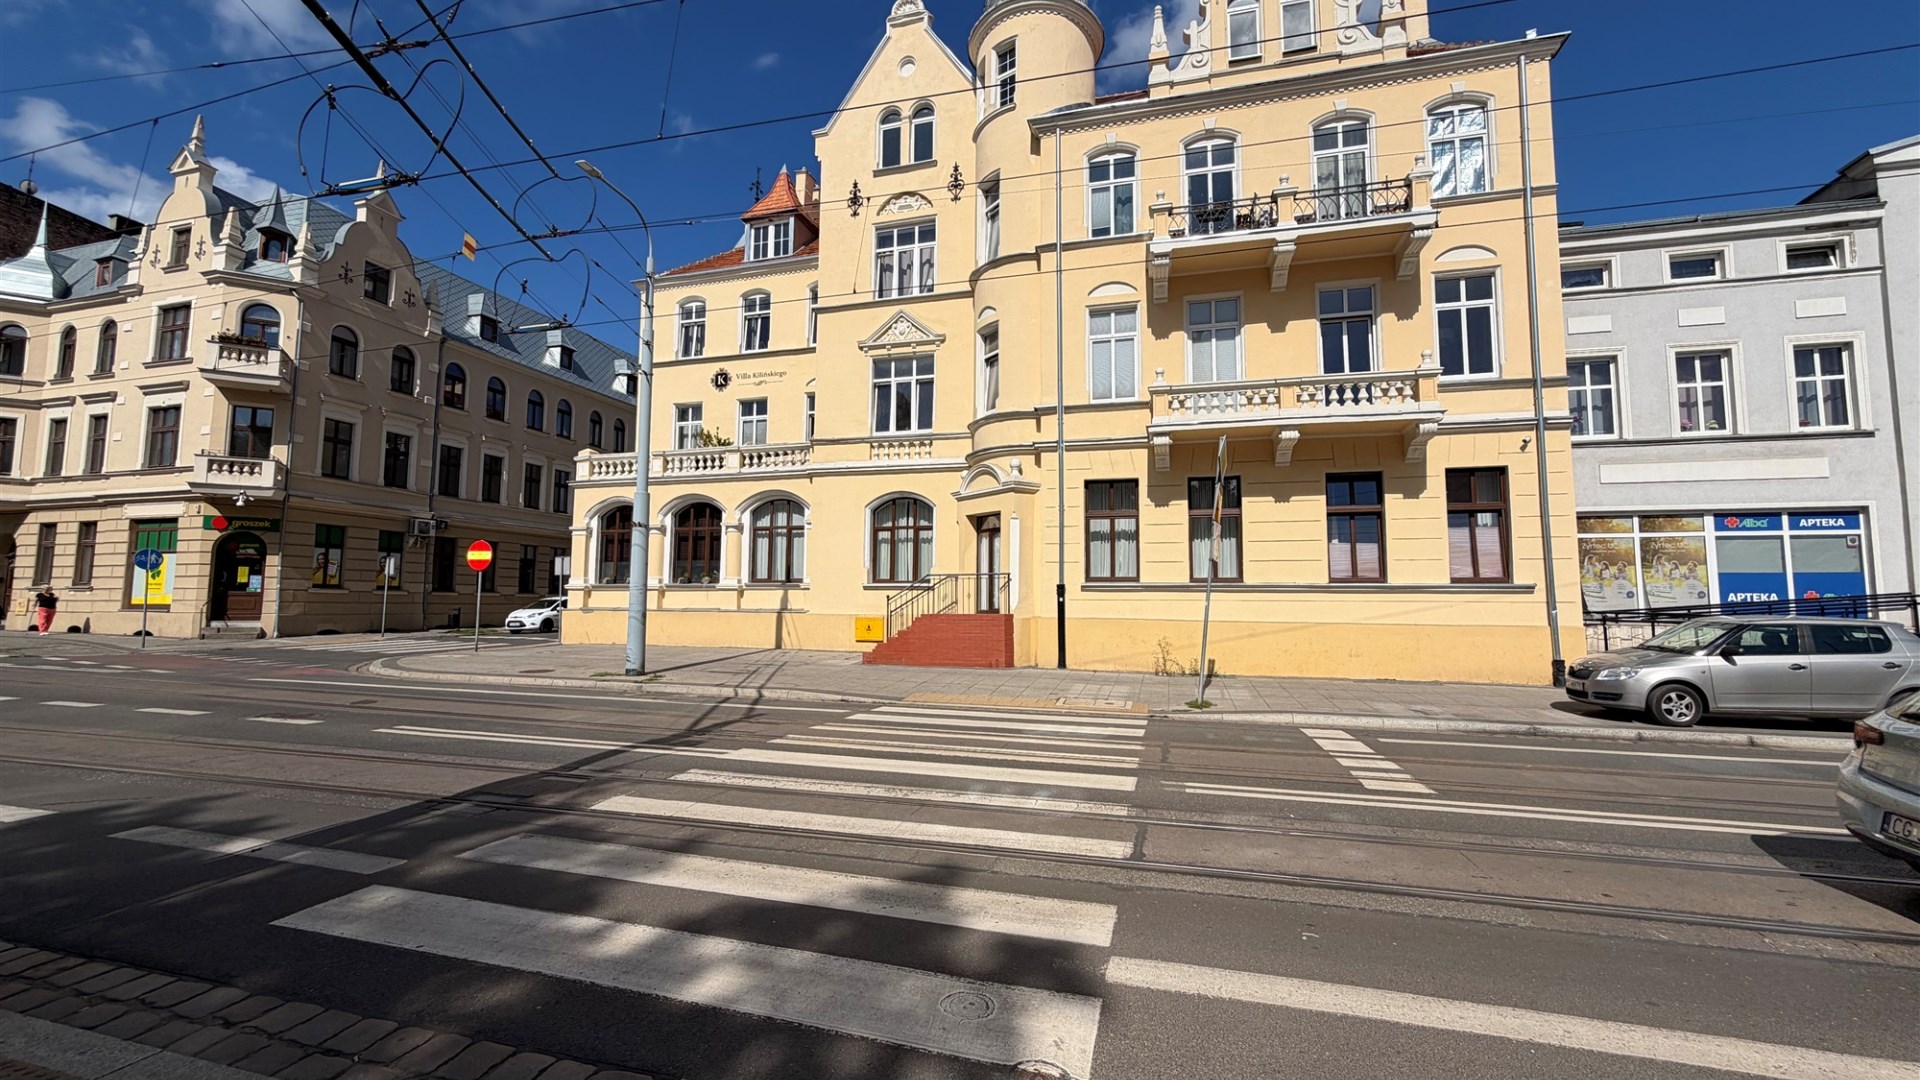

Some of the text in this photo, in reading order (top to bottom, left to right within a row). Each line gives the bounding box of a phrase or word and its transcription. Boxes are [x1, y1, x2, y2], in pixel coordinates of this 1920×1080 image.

[717, 375, 726, 385] K
[231, 520, 271, 528] groszek
[1799, 518, 1845, 527] APTEKA
[1727, 592, 1779, 602] APTEKA
[1893, 818, 1912, 837] CG
